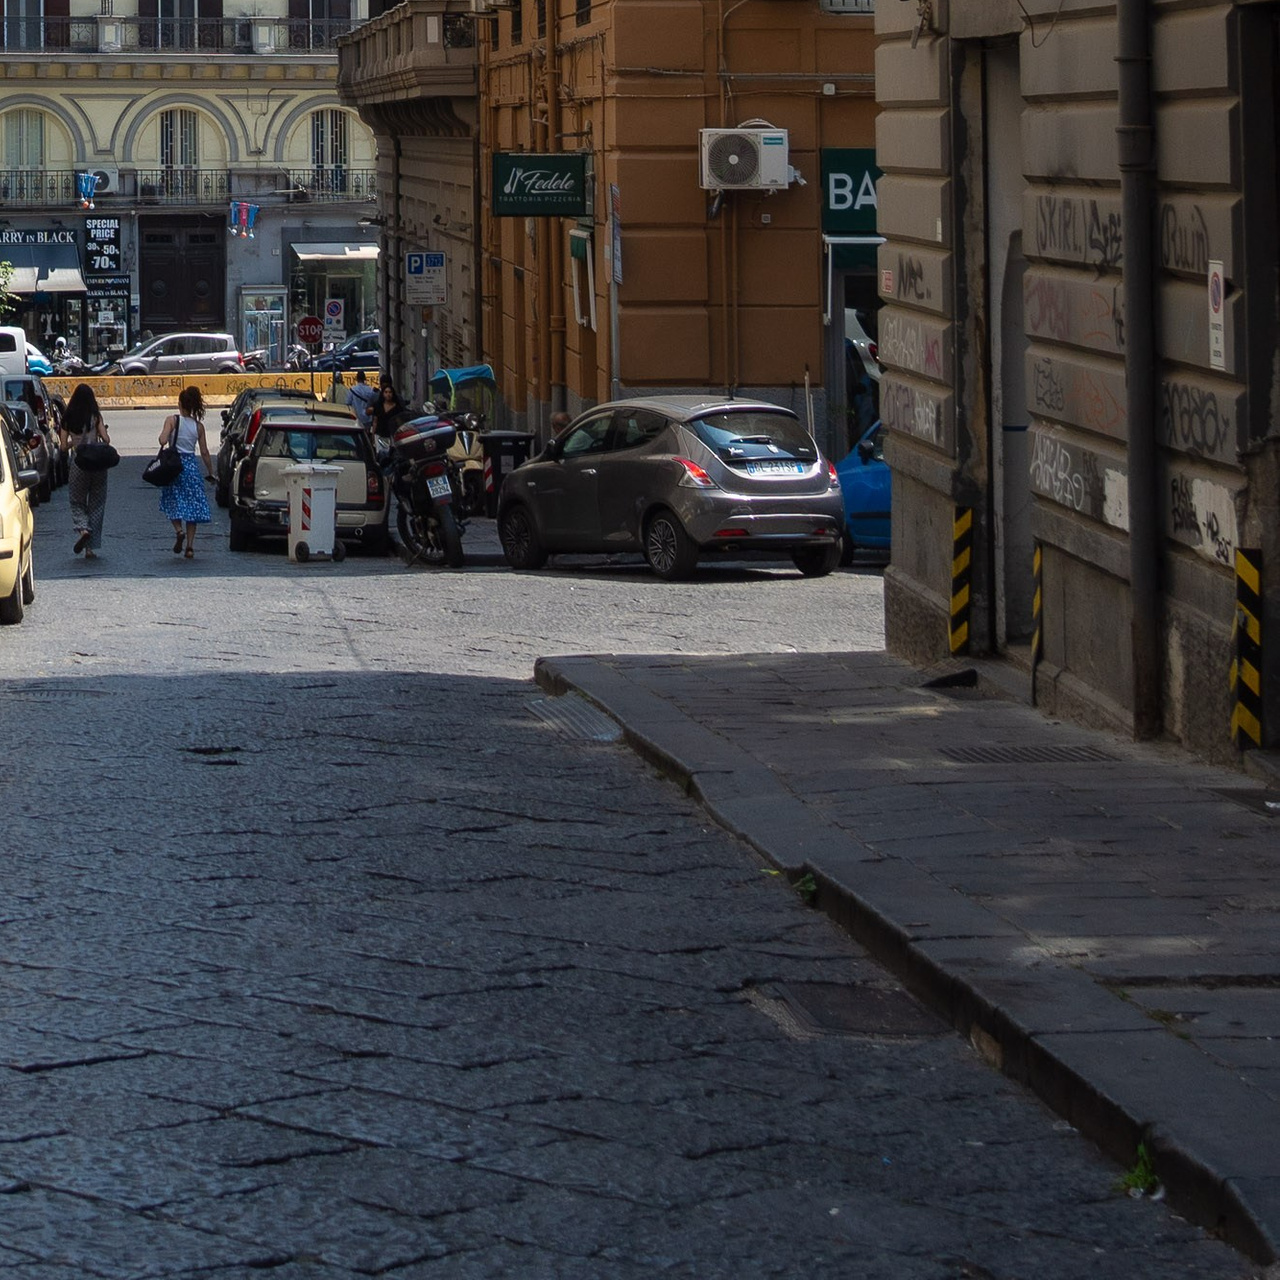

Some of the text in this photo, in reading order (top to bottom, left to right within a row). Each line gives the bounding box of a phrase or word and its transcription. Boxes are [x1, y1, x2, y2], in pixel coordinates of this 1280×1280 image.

[520, 170, 575, 193] Fedele
[86, 219, 119, 229] SPECIAL
[36, 231, 75, 243] BLACK
[90, 229, 115, 238] PRICE
[101, 244, 120, 255] -50%
[91, 255, 116, 269] -70%
[411, 256, 421, 272] P
[299, 324, 323, 336] STOP
